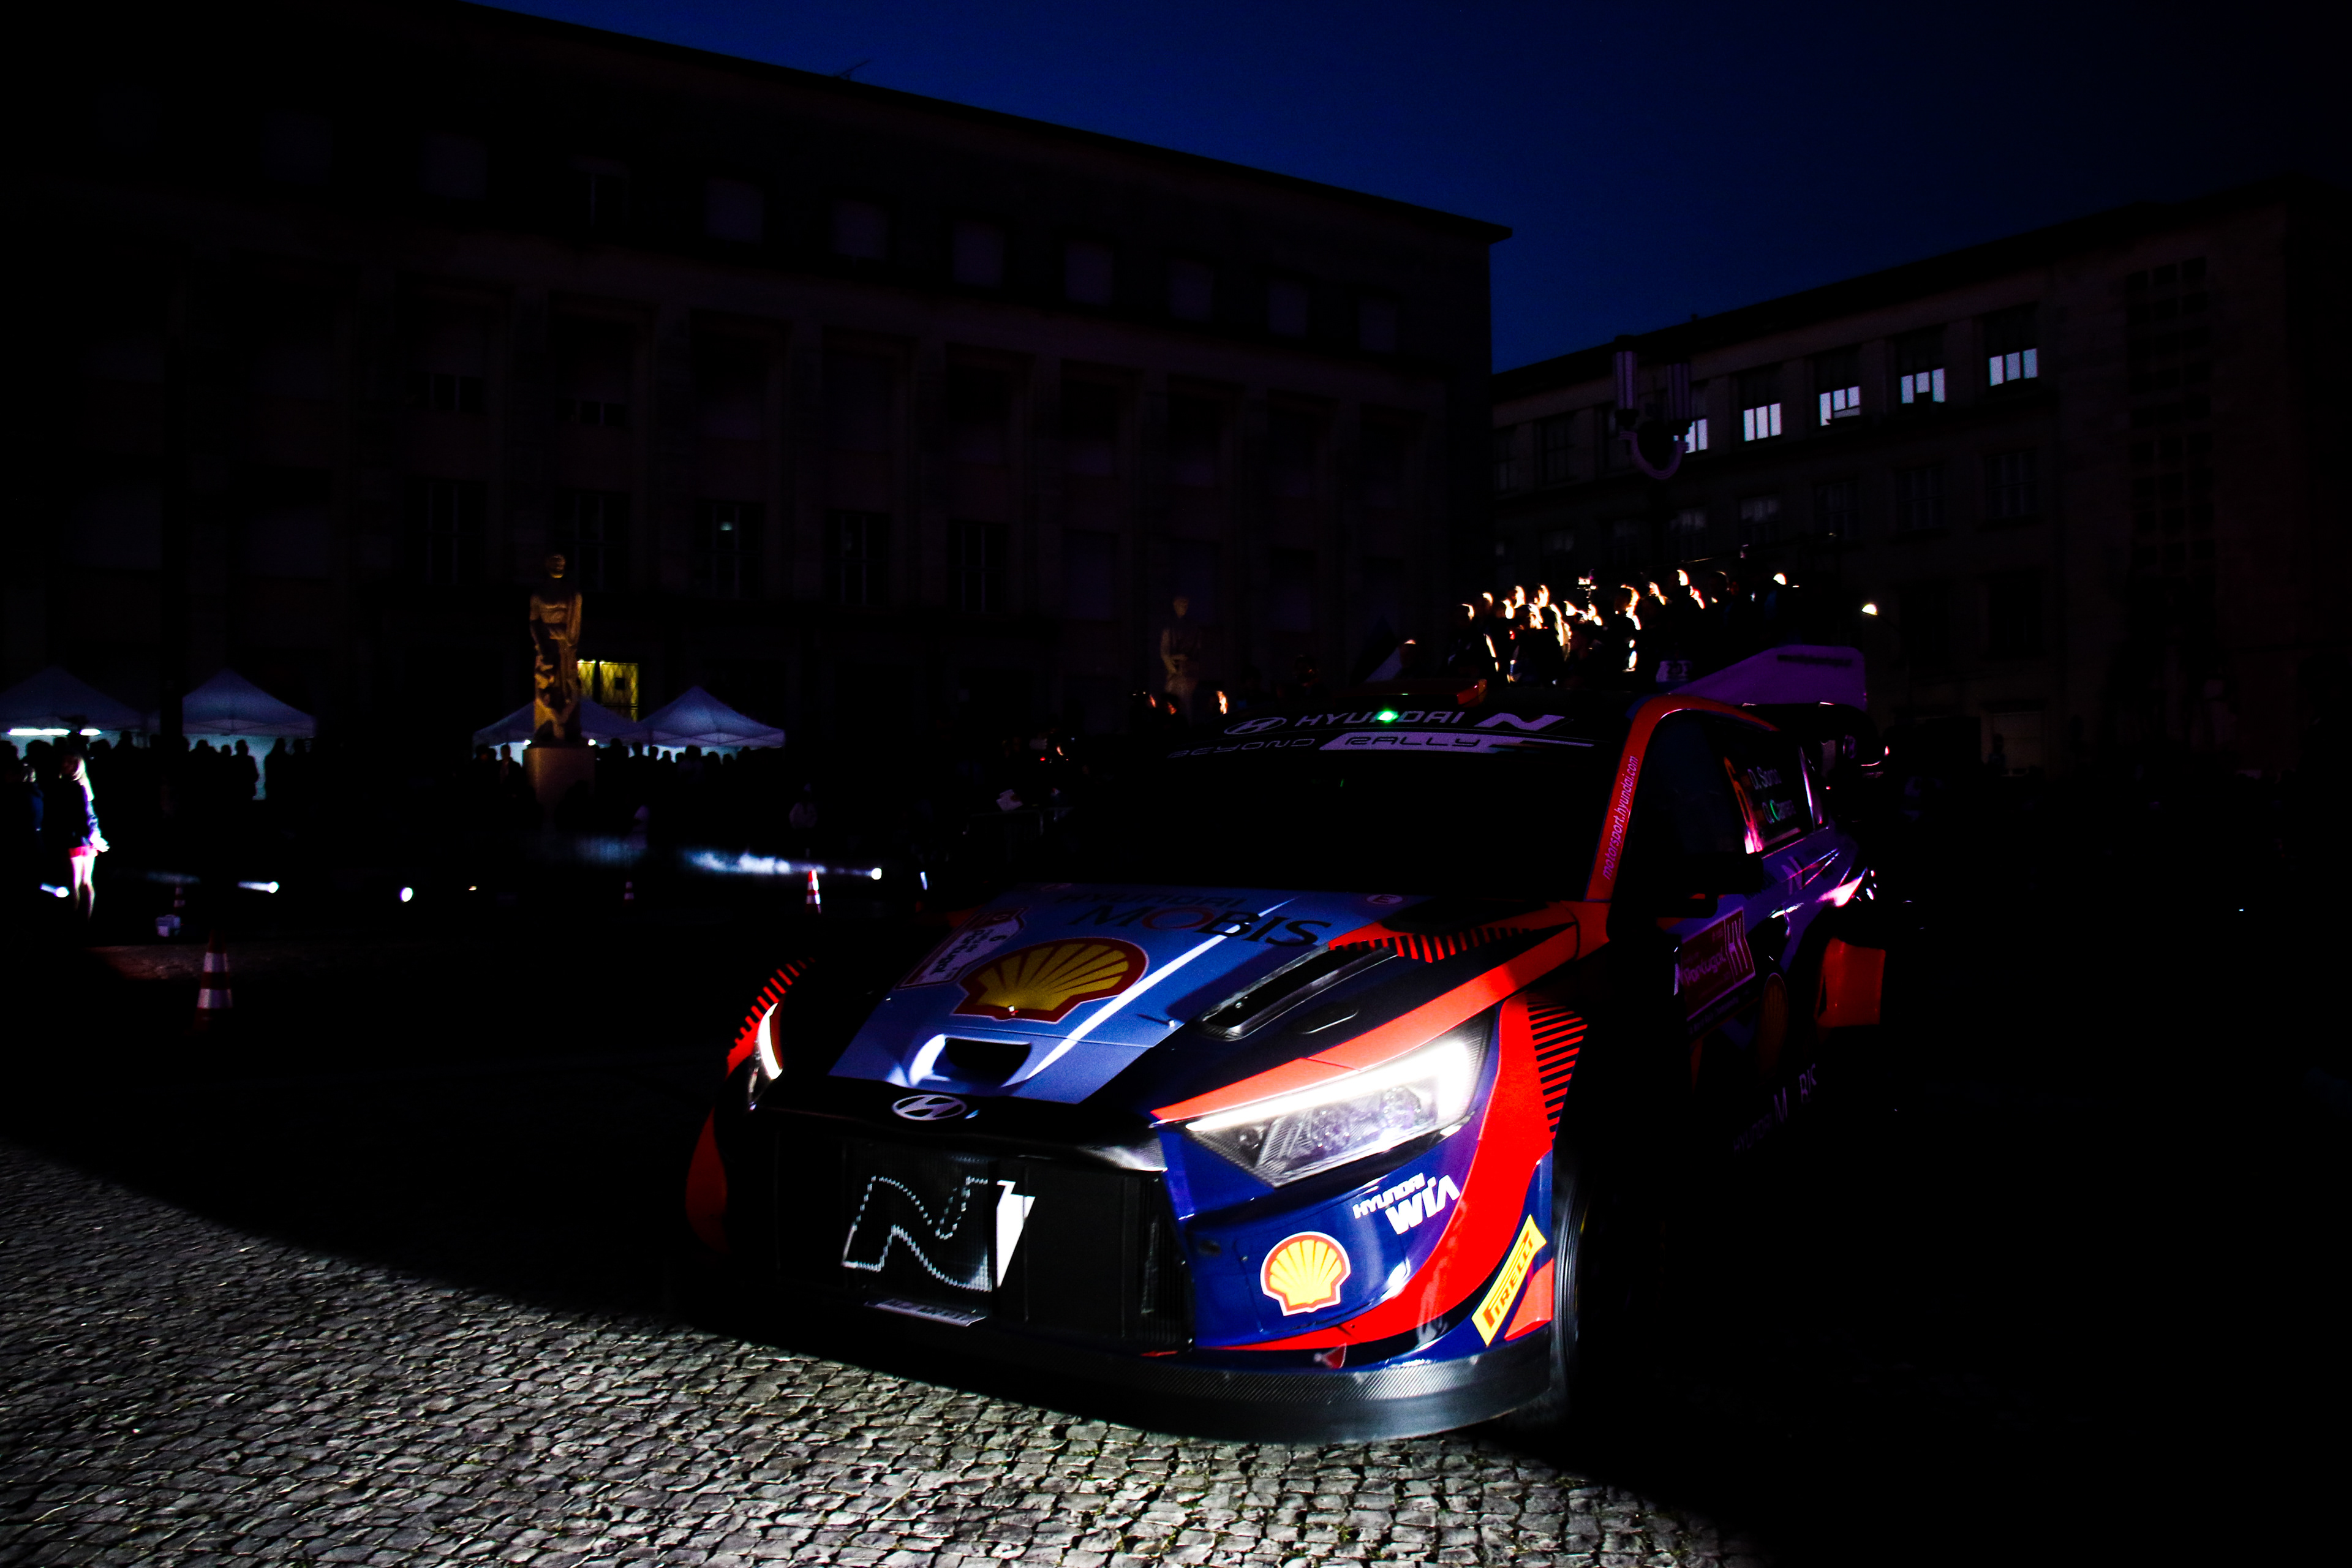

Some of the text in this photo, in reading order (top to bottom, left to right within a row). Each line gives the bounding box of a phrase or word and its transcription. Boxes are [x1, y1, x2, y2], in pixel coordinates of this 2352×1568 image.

[1294, 710, 1465, 727] HYUDAI
[1166, 736, 1480, 760] BEYOND RALLY
[1602, 755, 1639, 881] motorsport.hyundai.com
[1068, 905, 1332, 946] MOBIS
[1732, 1061, 1818, 1158] HYUNDAI MBIS
[1352, 1172, 1426, 1219] HYUNDAI
[1482, 1230, 1534, 1329] PIRELLI
